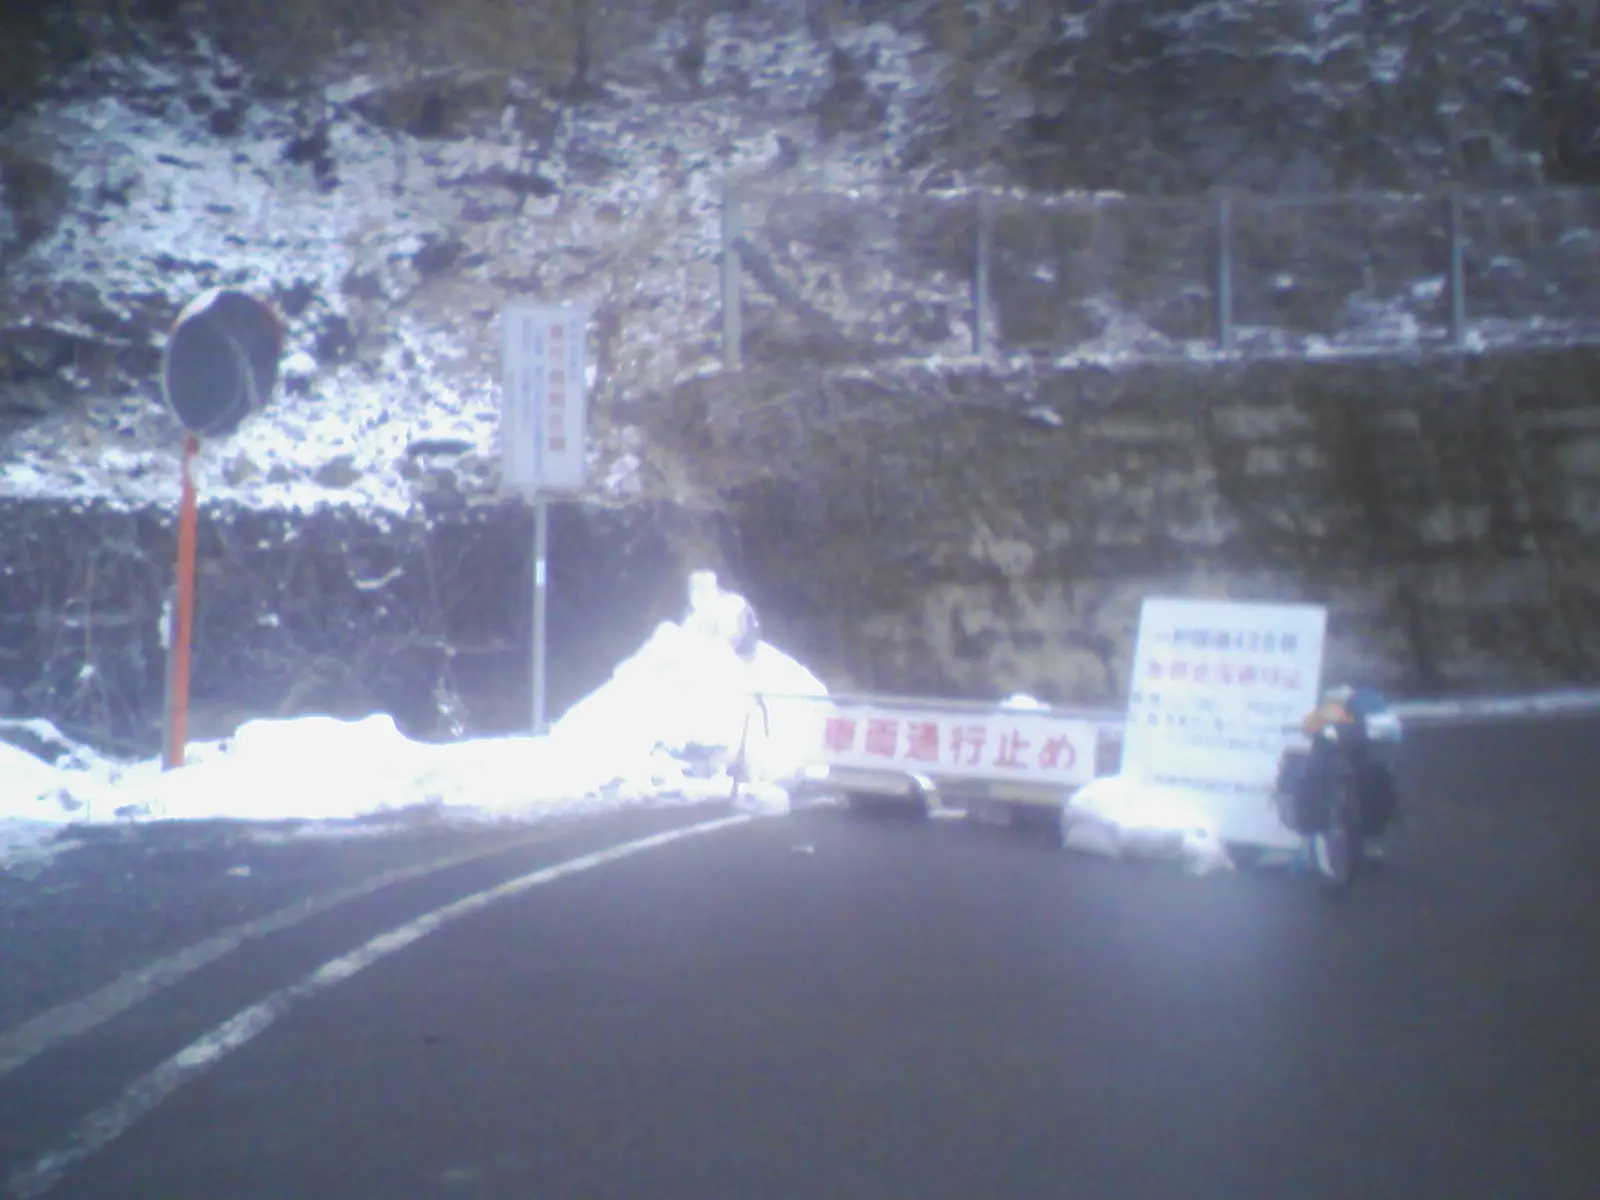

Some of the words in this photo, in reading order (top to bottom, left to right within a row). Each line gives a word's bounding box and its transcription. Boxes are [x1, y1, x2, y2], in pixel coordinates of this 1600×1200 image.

[824, 716, 1077, 770] 車両通行止め
